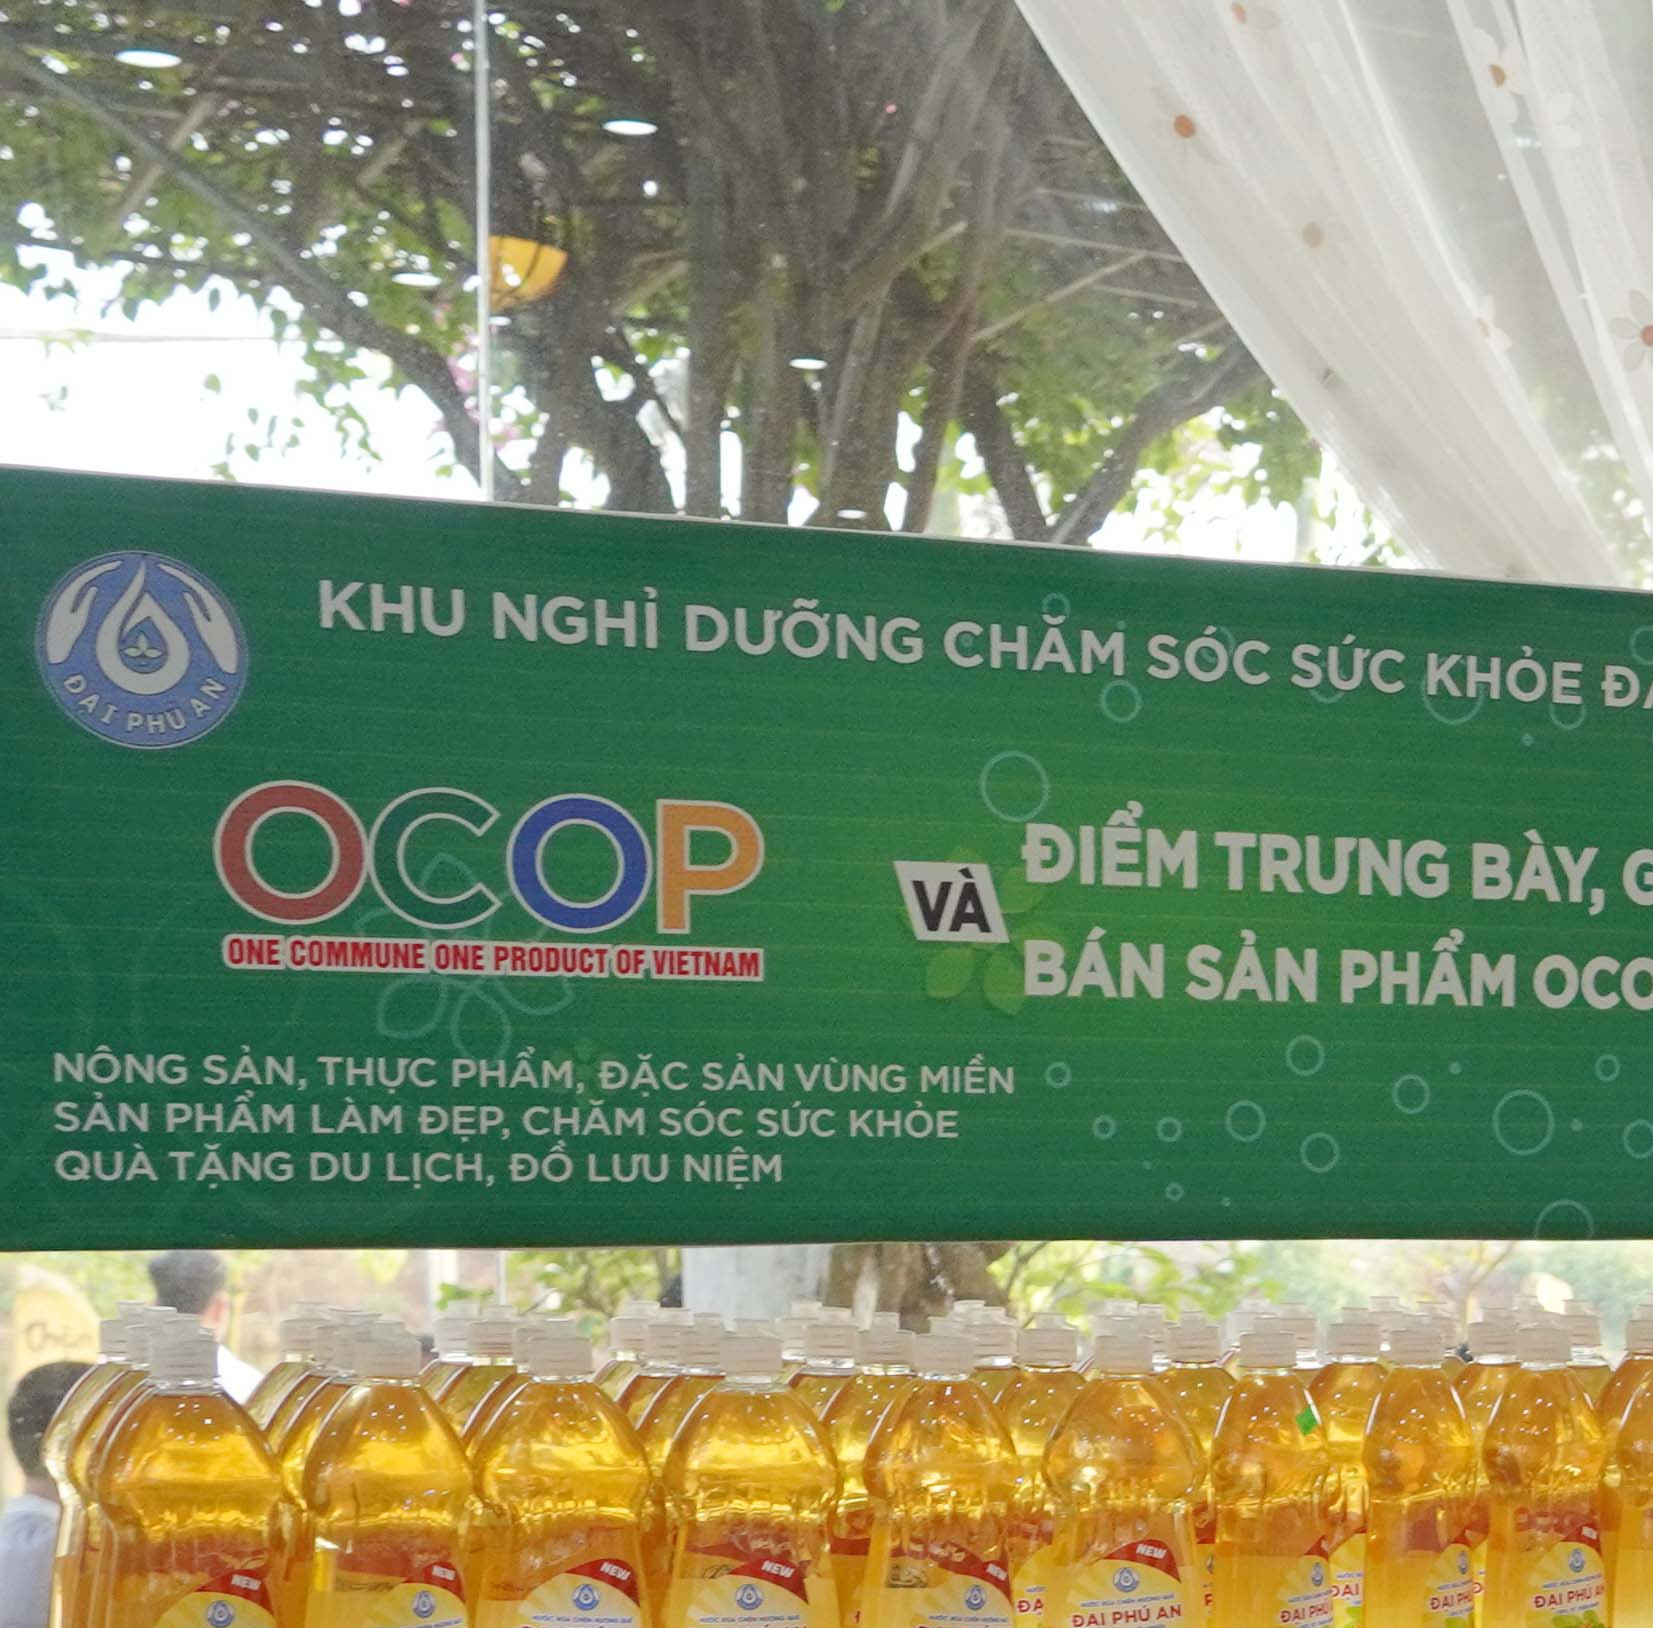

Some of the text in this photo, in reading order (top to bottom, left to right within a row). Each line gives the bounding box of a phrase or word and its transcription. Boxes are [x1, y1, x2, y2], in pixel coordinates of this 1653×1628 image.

[320, 580, 464, 636] KHU
[493, 587, 657, 648] NGHỈ
[686, 598, 923, 663] DƯỠNG
[944, 615, 1124, 675] CHĂM
[1148, 626, 1270, 684] SÓC
[1291, 635, 1404, 693] SỨC
[1427, 646, 1582, 704] KHỎE
[190, 677, 226, 718] AN
[213, 779, 766, 935] OCOP
[1022, 801, 1198, 888] ĐIỂM
[1214, 832, 1449, 898] TRƯNG
[1472, 829, 1604, 915] BÀY,
[913, 866, 992, 933] VÀ
[228, 938, 760, 978] ONE COMMUNE ONE PRODUCT OF VIETNAM
[1024, 927, 1164, 998] BÁN
[1186, 929, 1317, 1002] SẢN
[1341, 929, 1515, 1007] PHẨM
[54, 1045, 1014, 1096] NÔNG SẢN, THỰC PHẨM, ĐẶC SẢN VÙNG MIỀN
[54, 1090, 958, 1139] SẢN PHẨM LÀM ĐẸP, CHĂM SÓC SỨC KHỎE
[55, 1140, 782, 1189] QUÀ TẶNG DU LỊCH, ĐỒ LƯU NIỆM
[601, 1562, 631, 1580] NEW
[761, 1560, 796, 1578] NEW
[1136, 1543, 1167, 1559] NEW
